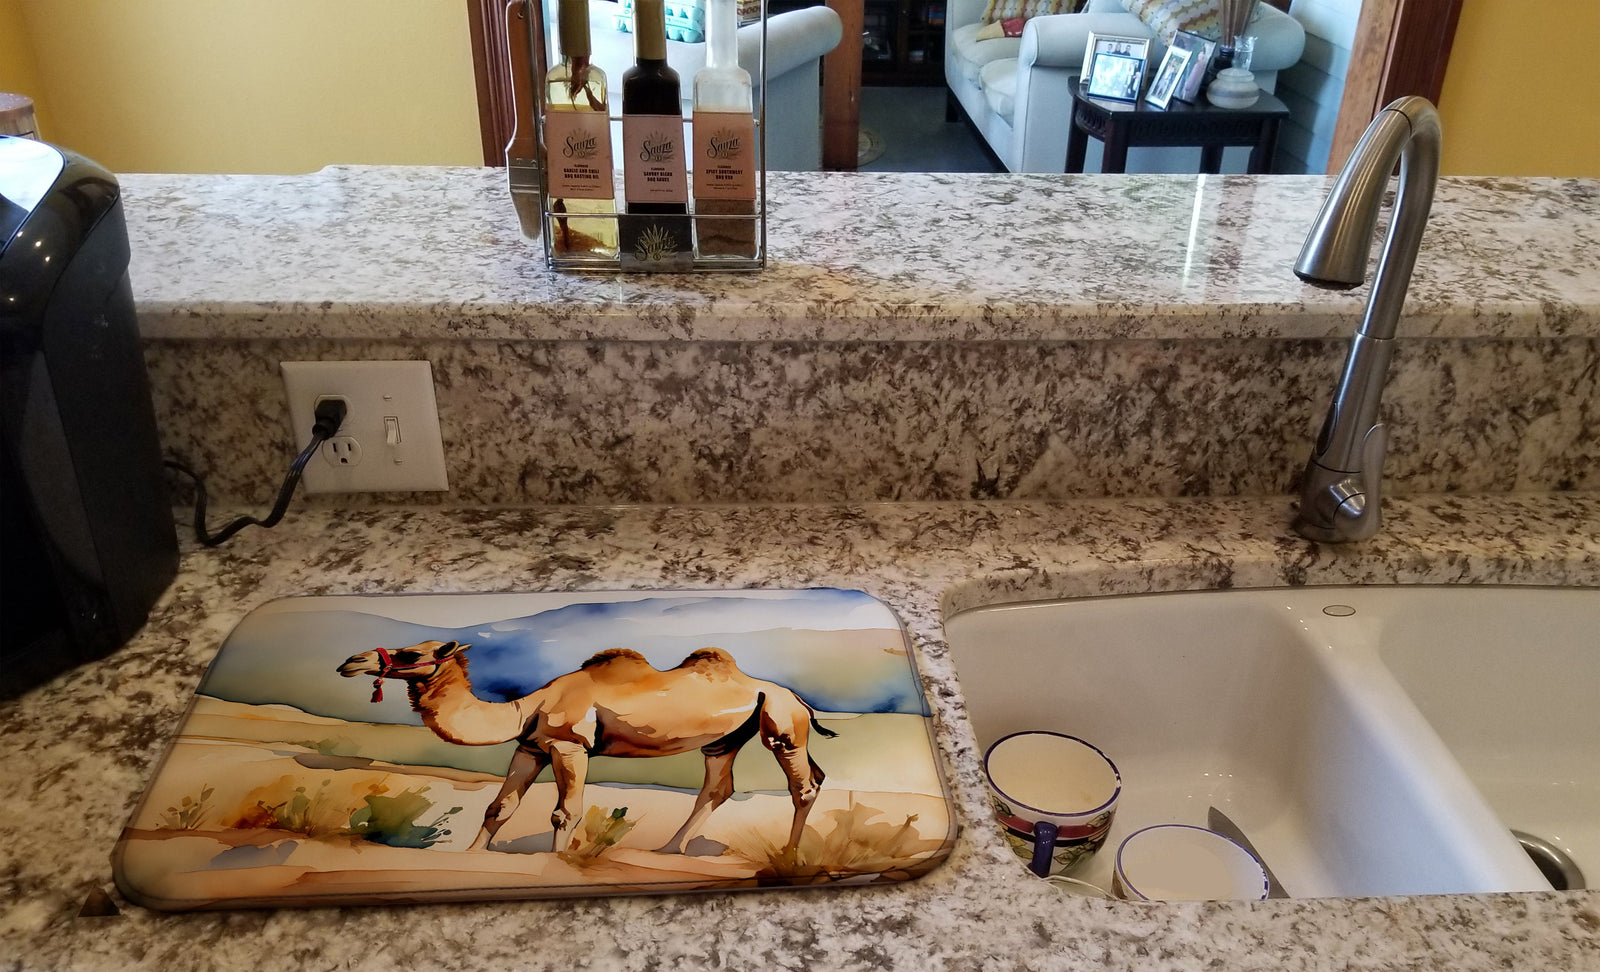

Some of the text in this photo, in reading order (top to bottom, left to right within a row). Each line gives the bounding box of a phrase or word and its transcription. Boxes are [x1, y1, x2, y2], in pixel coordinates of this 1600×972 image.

[562, 136, 598, 158] Sauza
[640, 139, 674, 161] Sauza
[706, 136, 740, 159] Sauza
